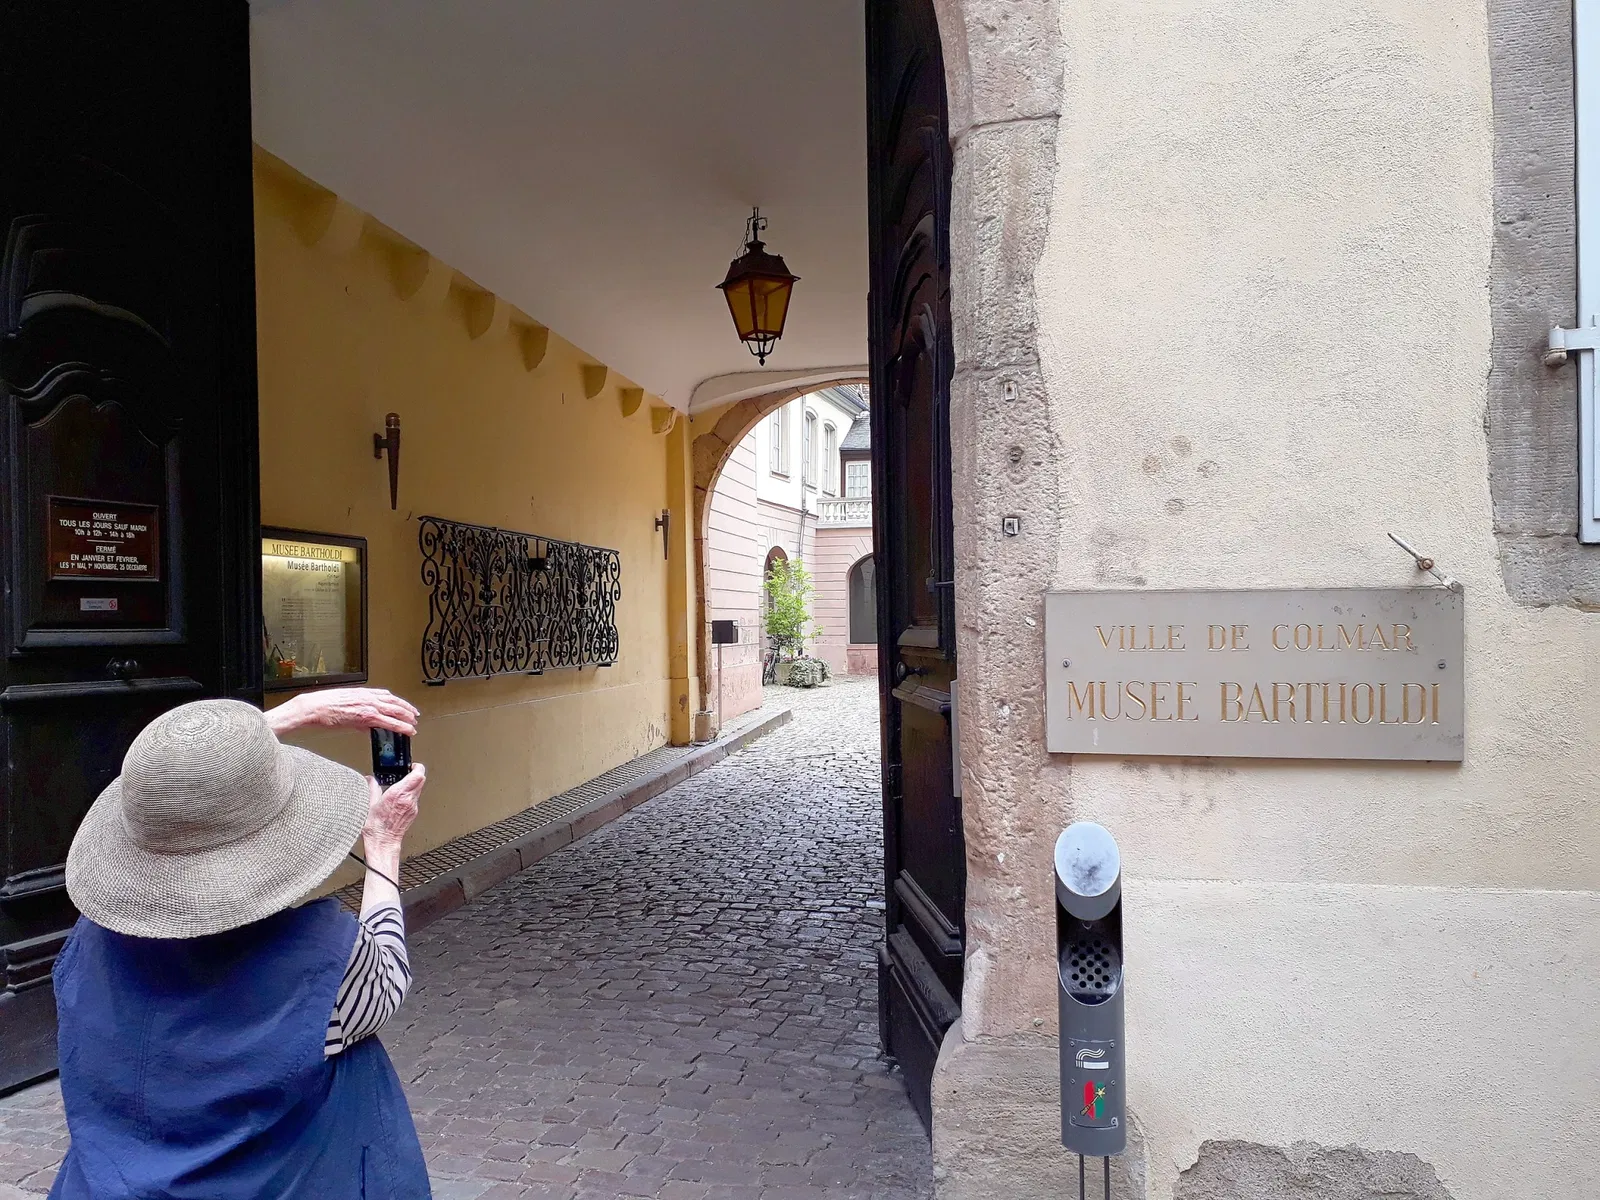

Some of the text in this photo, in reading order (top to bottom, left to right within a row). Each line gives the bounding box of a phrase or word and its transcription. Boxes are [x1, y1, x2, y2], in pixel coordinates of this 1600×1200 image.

[92, 512, 117, 520] OUVERT
[59, 519, 77, 527] TOUS
[92, 522, 112, 530] JOURS
[130, 524, 147, 532] MARDI
[82, 554, 105, 562] JANVIER
[271, 544, 343, 560] MUSEE BARTHOLDI
[287, 560, 340, 573] Musée Bartholdi
[1094, 623, 1414, 653] VILLE DE COLMAR
[1066, 680, 1441, 726] MUSEE BARTHOLDI
